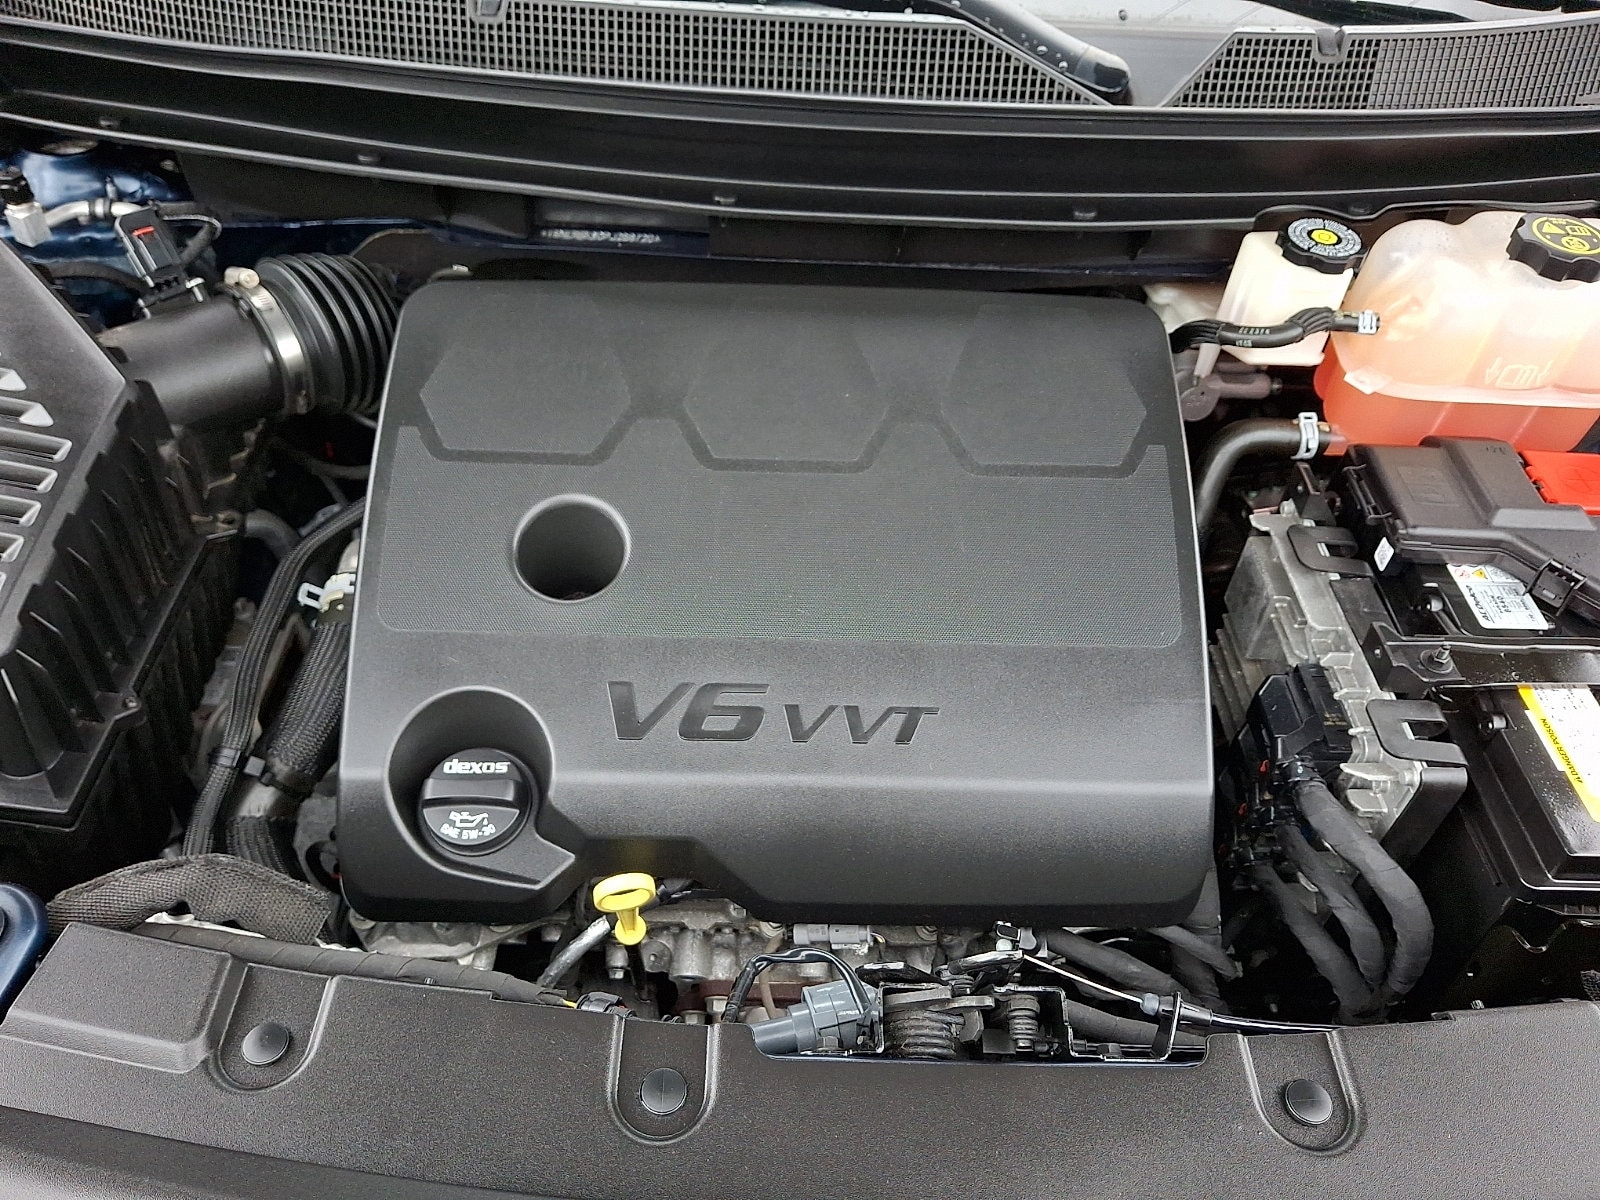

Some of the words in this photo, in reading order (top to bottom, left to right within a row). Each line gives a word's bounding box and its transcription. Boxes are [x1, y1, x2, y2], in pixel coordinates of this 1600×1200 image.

[607, 681, 769, 741] V6
[784, 704, 940, 744] VVT
[1540, 718, 1559, 745] POISON
[443, 759, 510, 774] dexos
[1557, 747, 1578, 776] DANGER
[440, 823, 460, 838] SAE
[461, 823, 496, 840] 5W-30
